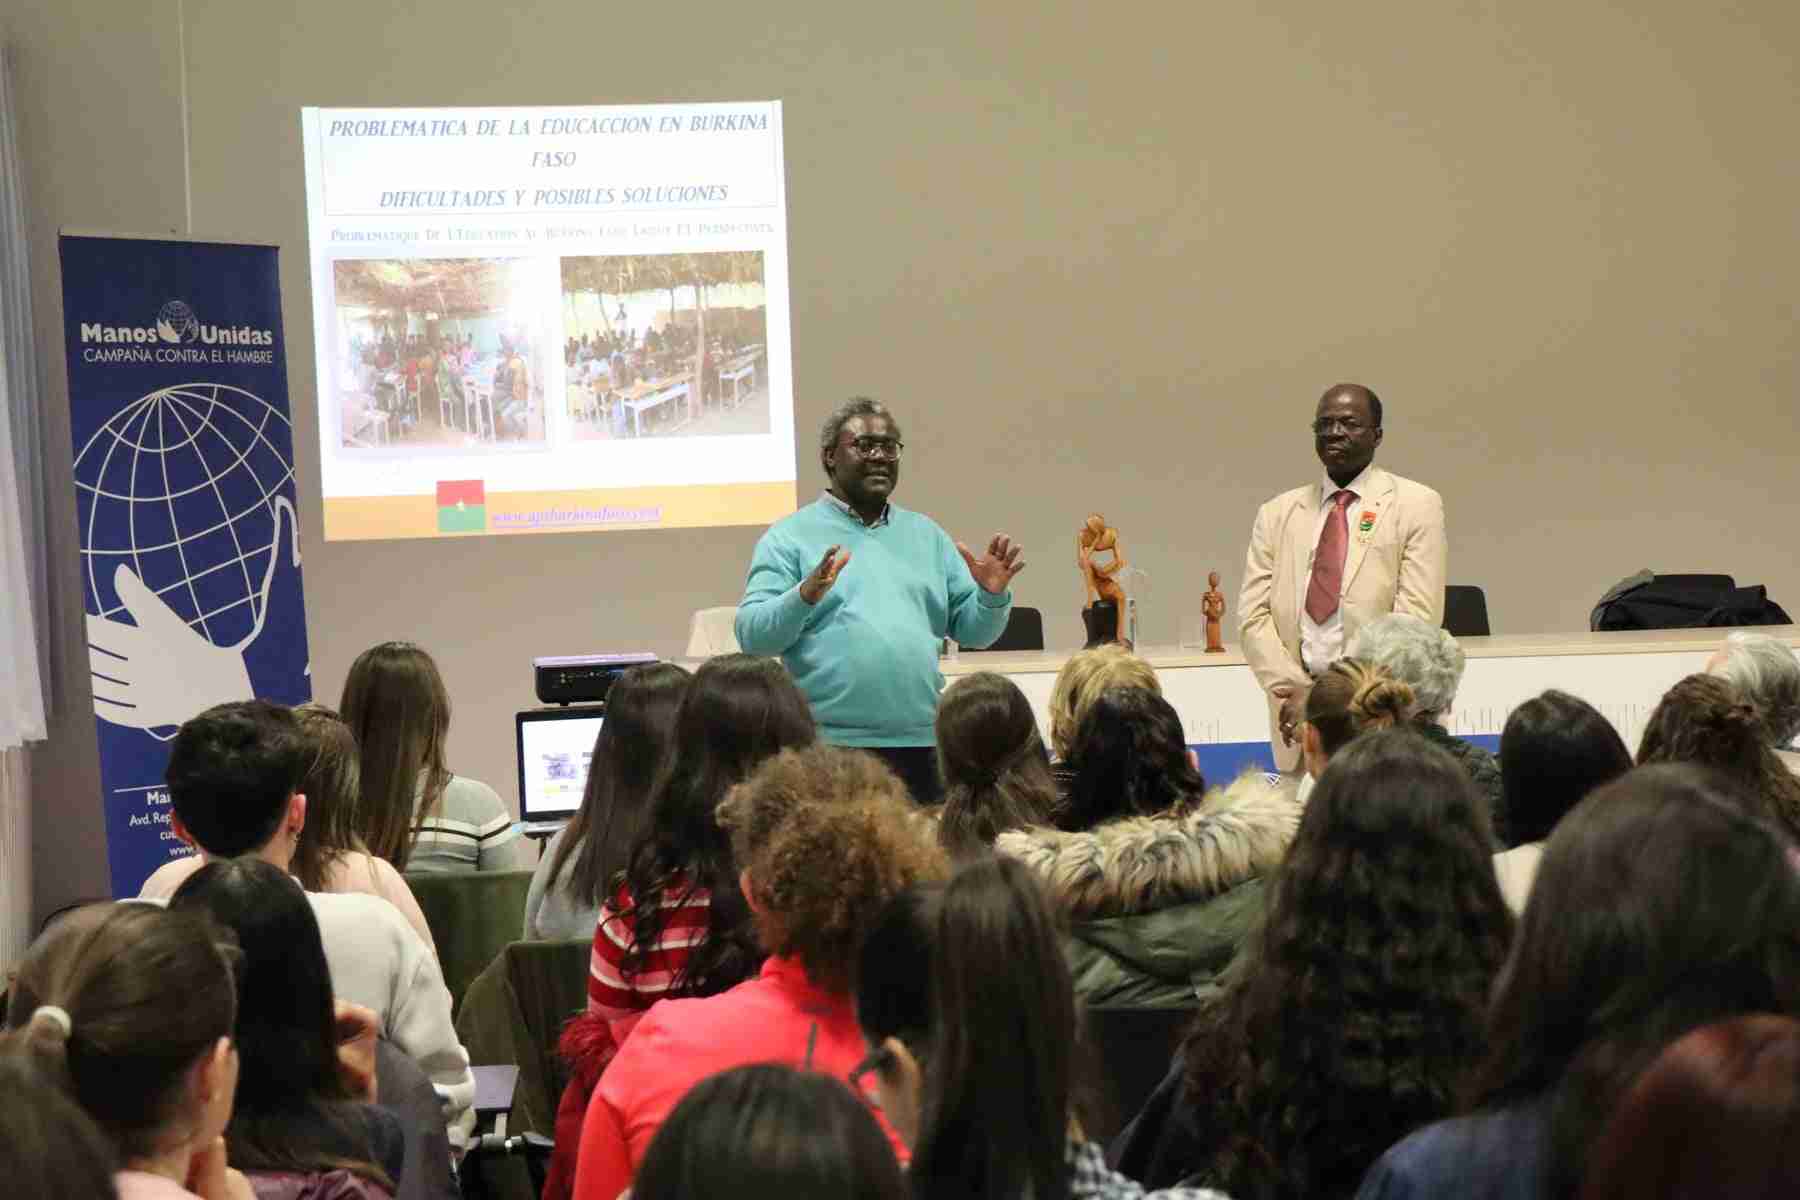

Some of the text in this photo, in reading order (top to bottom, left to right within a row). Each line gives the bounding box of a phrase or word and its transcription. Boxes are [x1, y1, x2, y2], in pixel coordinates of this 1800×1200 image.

[330, 114, 768, 136] PROBLEMATICA DE LA EDUCACCION EN BURKINA
[531, 151, 576, 168] FASO
[379, 184, 728, 208] DIFICULTADES Y POSIBLES SOLUCIONES
[81, 322, 273, 345] Manos Unidas
[84, 345, 272, 364] CAMPAÑA CONTRA EL HAMBRE
